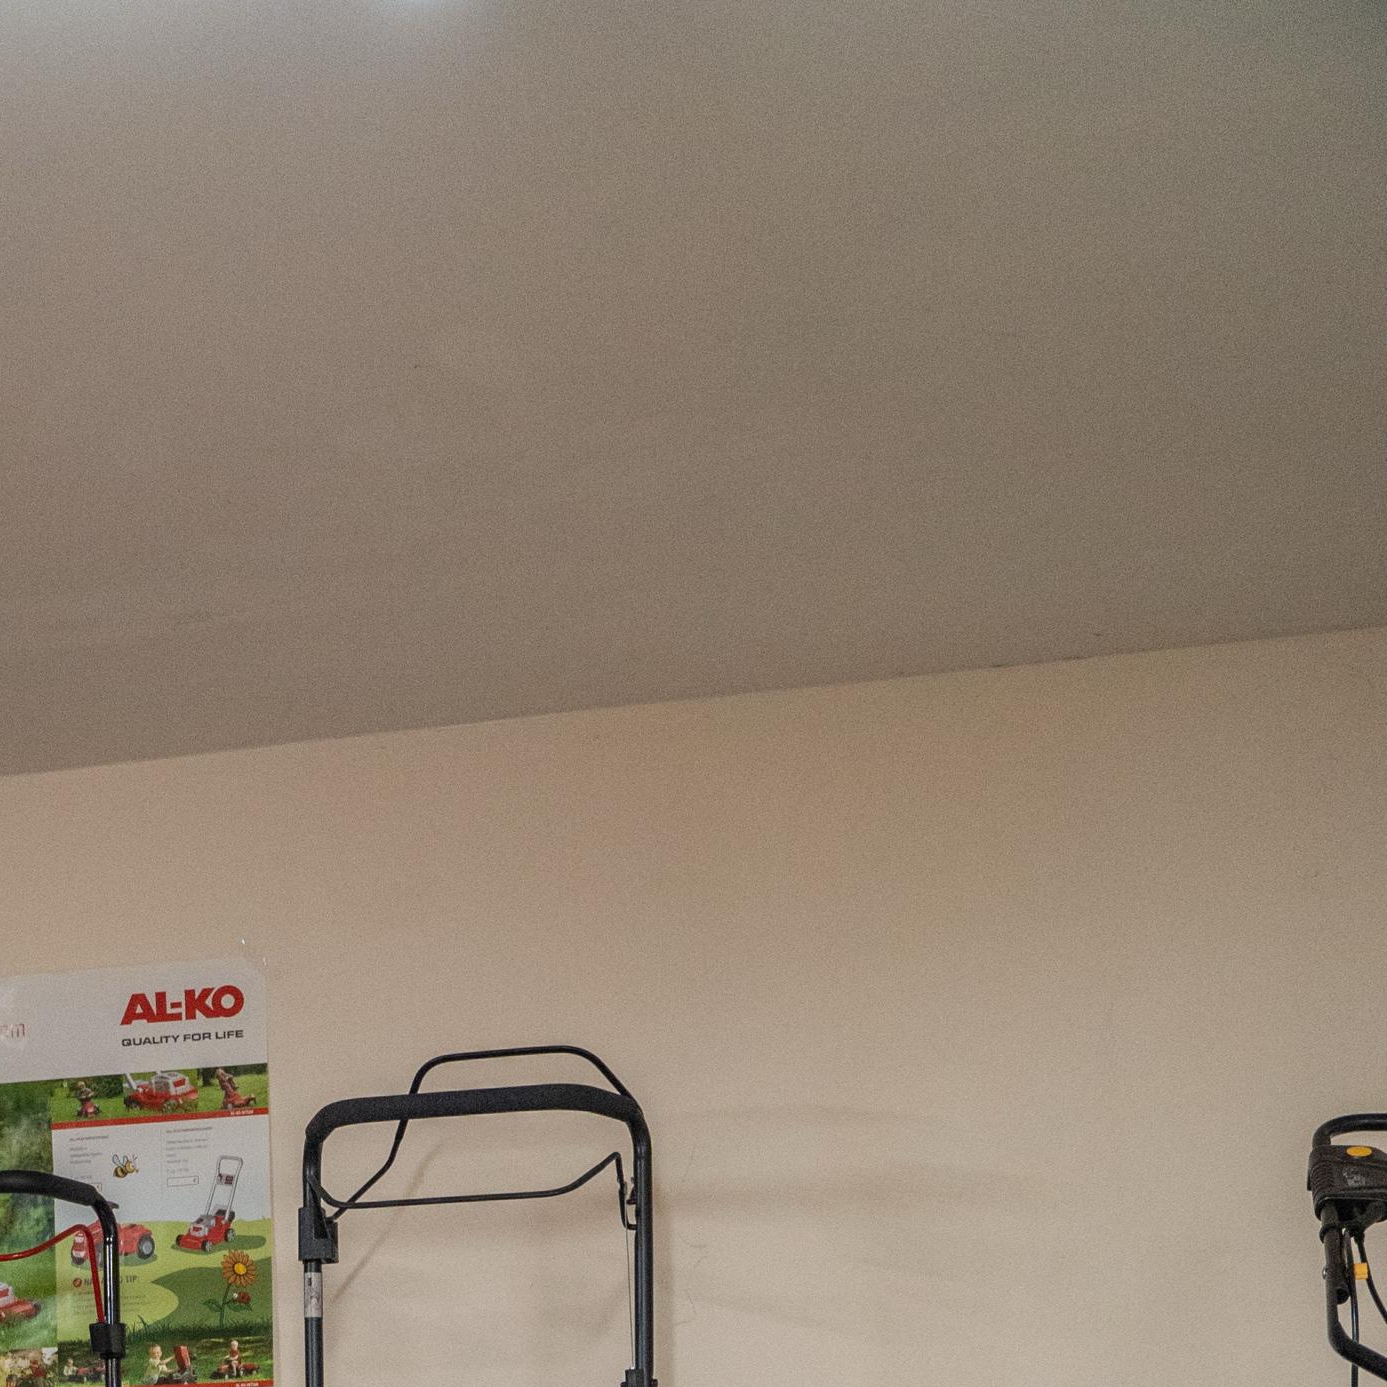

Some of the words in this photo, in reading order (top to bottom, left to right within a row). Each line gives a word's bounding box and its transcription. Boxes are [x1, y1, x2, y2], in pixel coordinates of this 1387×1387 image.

[120, 985, 245, 1026] AL-KO
[121, 1034, 180, 1047] QUALITY
[183, 1032, 212, 1042] FOR
[215, 1030, 244, 1040] LIFE
